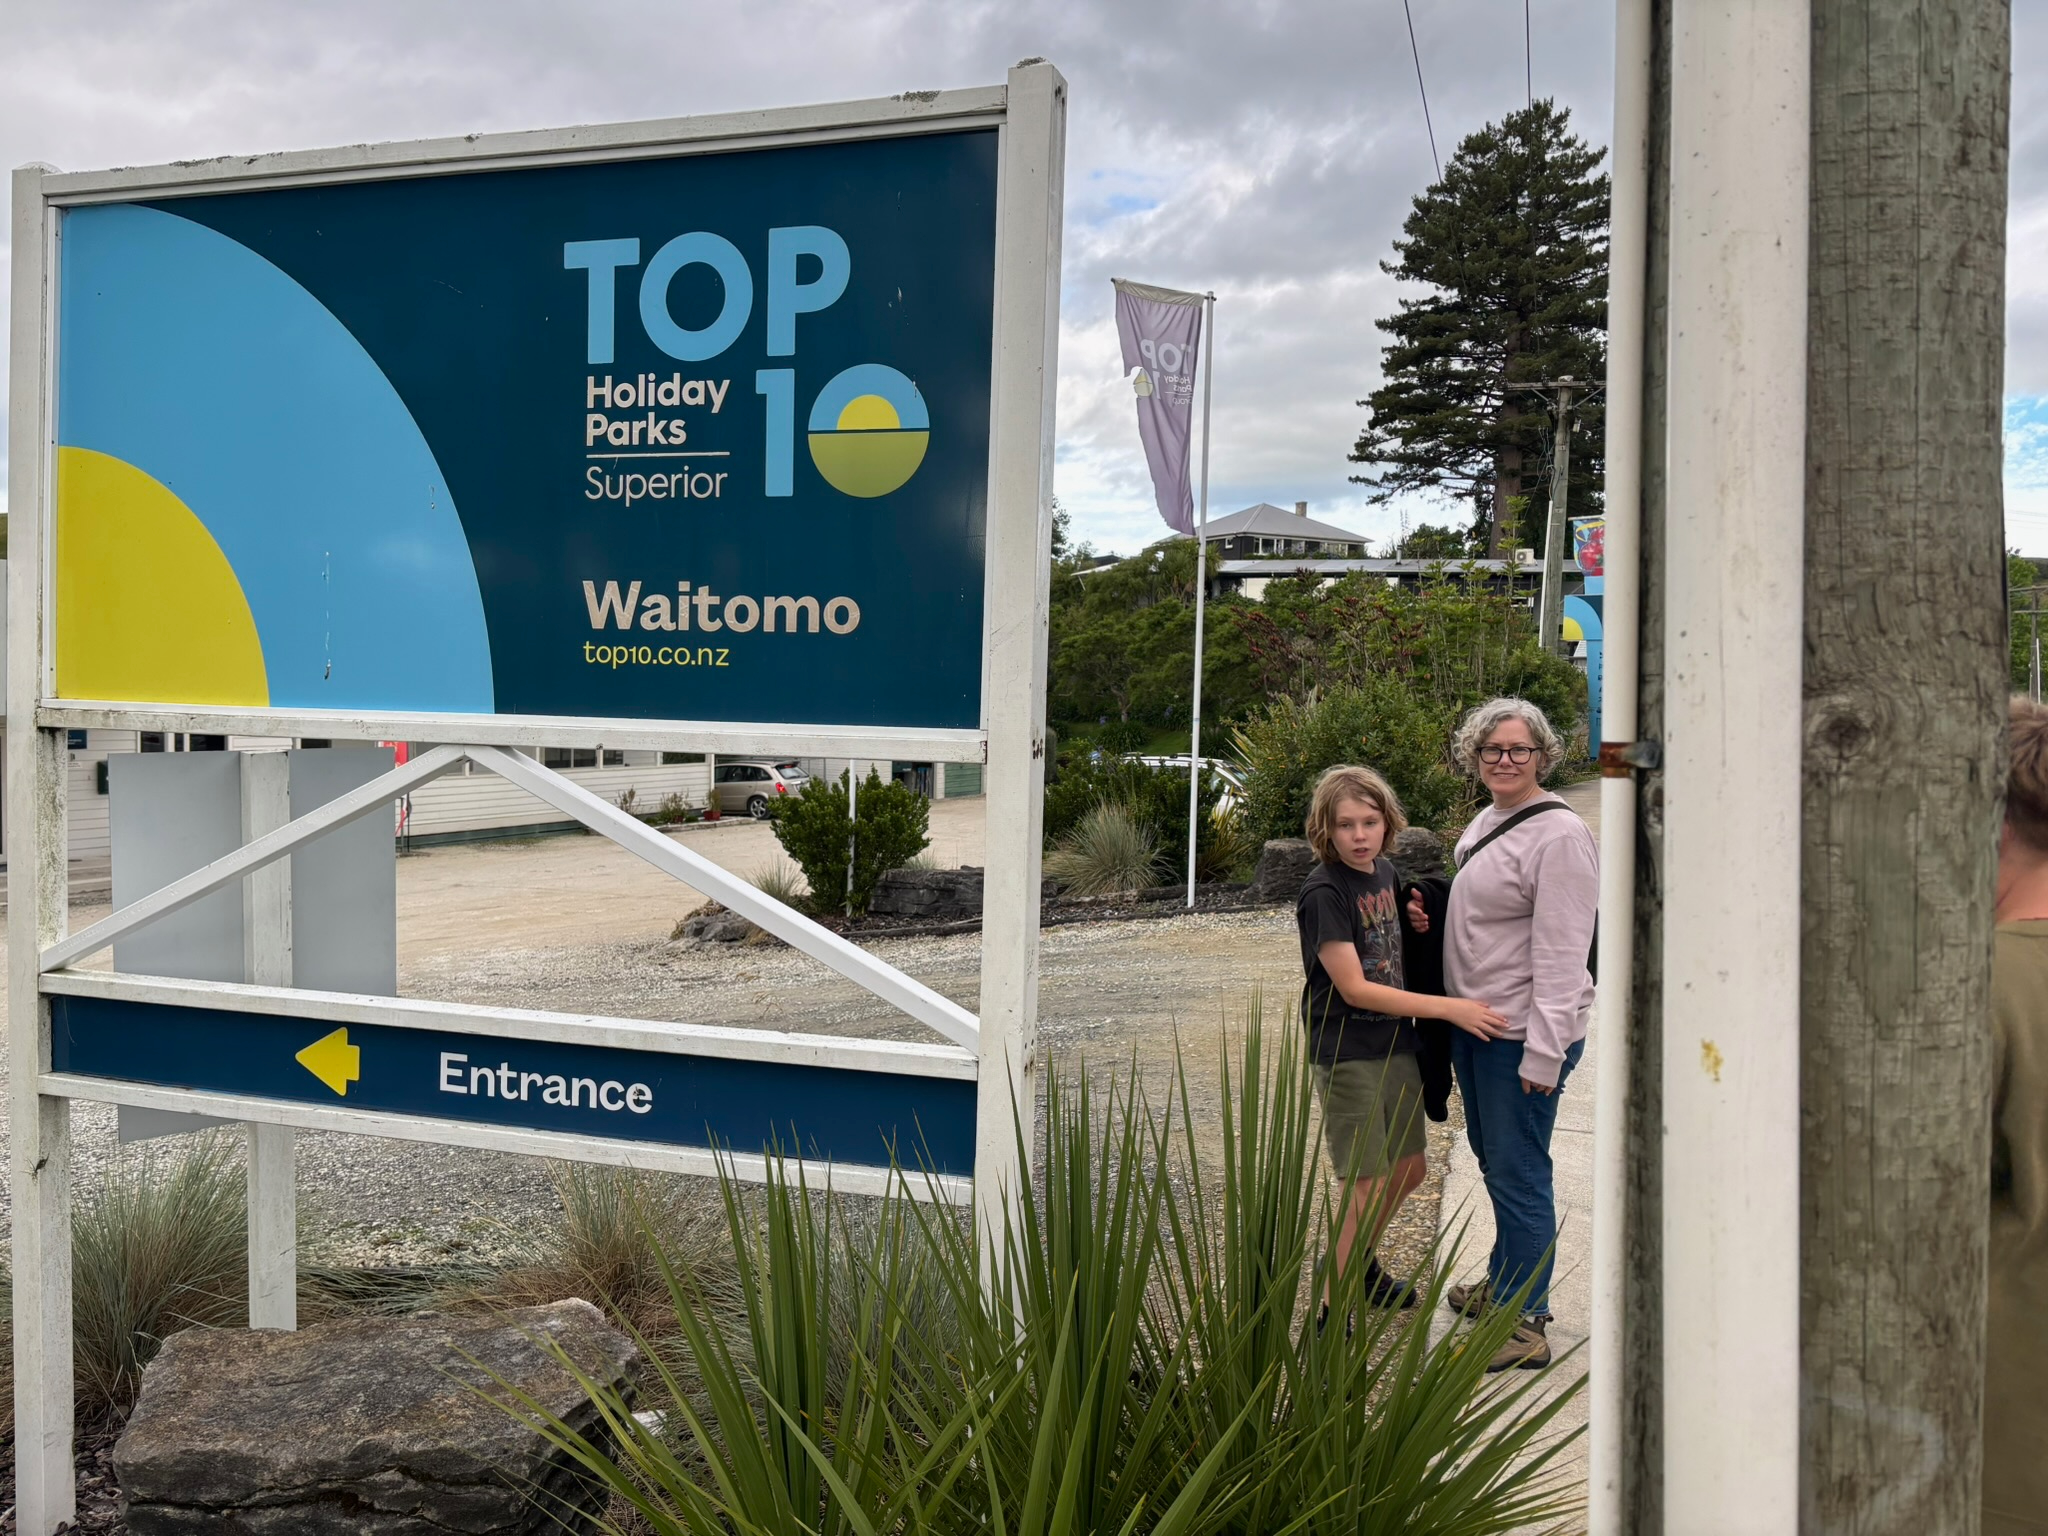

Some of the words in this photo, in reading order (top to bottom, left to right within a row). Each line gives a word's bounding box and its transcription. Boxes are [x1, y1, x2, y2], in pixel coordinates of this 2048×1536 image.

[563, 225, 851, 364] TOP
[586, 372, 731, 413] Holiday
[586, 411, 687, 447] Parks
[584, 465, 728, 507] Superior
[582, 580, 861, 635] Waitomo
[582, 640, 730, 670] top10.co.nz
[439, 1051, 653, 1114] Entrance
